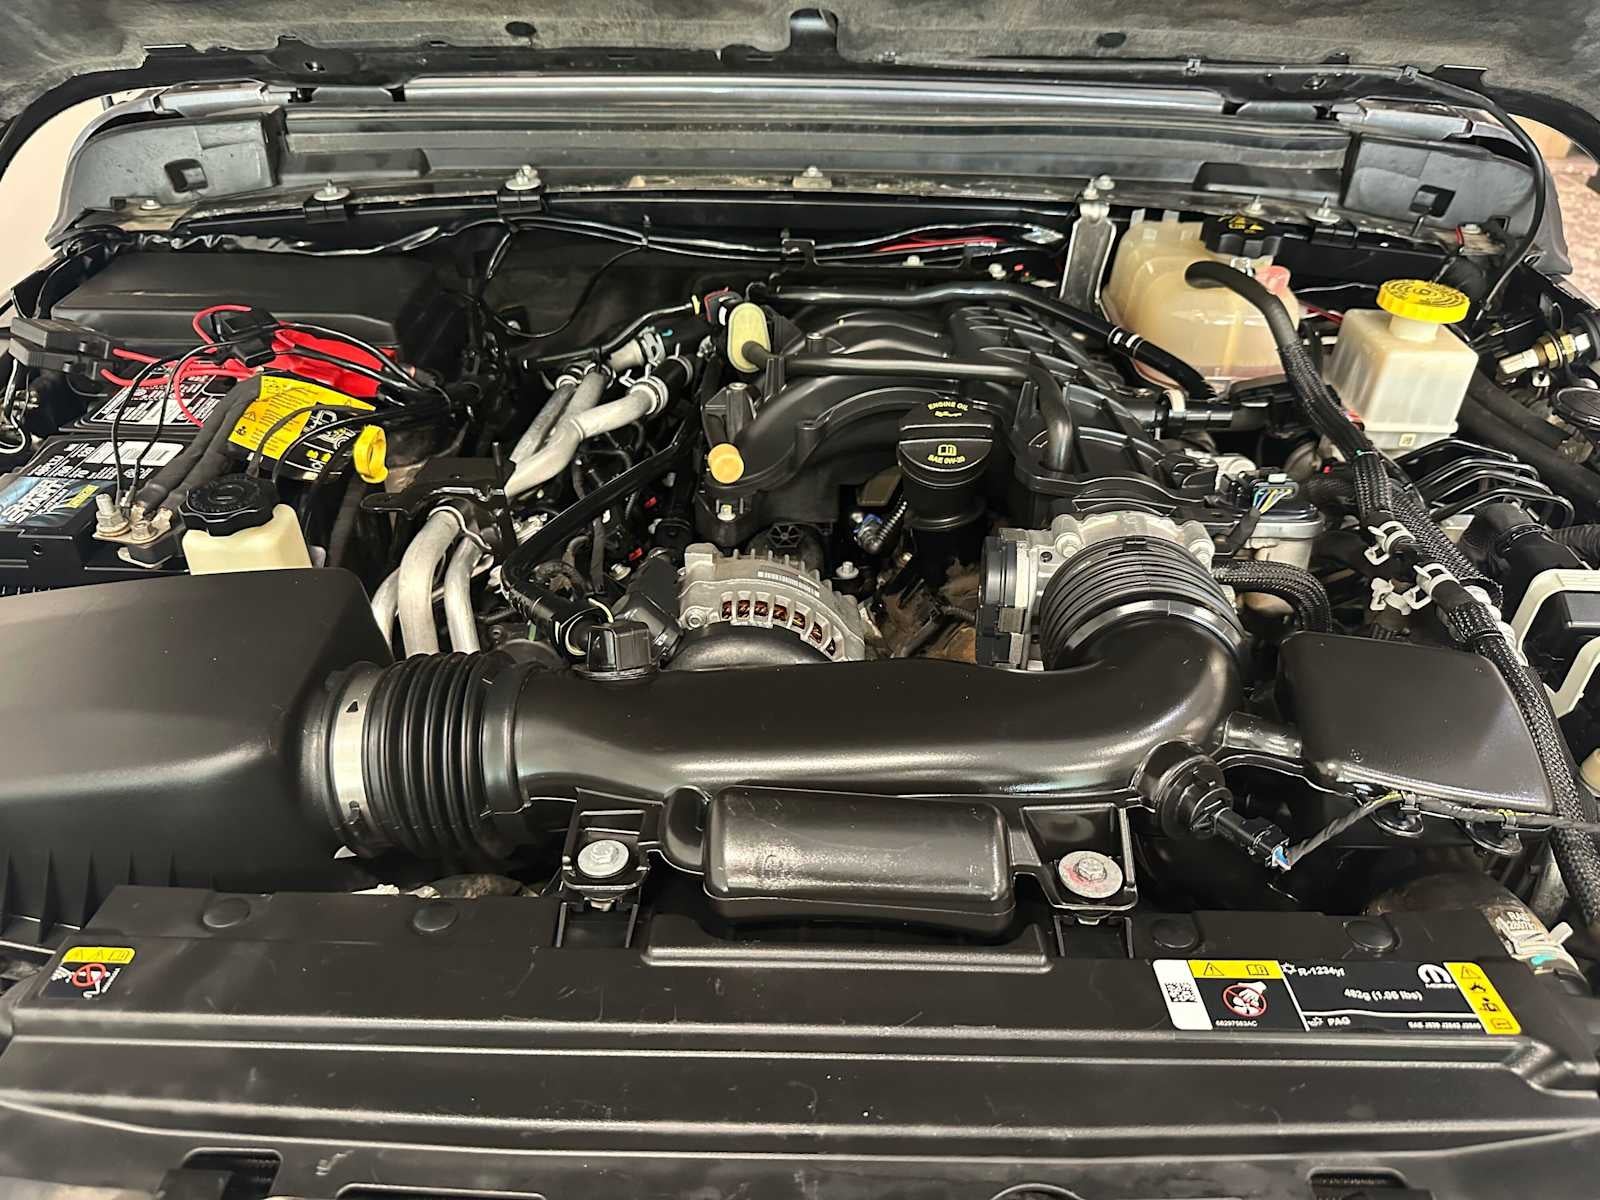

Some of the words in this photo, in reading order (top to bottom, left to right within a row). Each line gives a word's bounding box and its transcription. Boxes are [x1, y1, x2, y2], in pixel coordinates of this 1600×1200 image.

[927, 401, 956, 410] ENGINE
[957, 403, 969, 411] OIL
[7, 480, 64, 524] START
